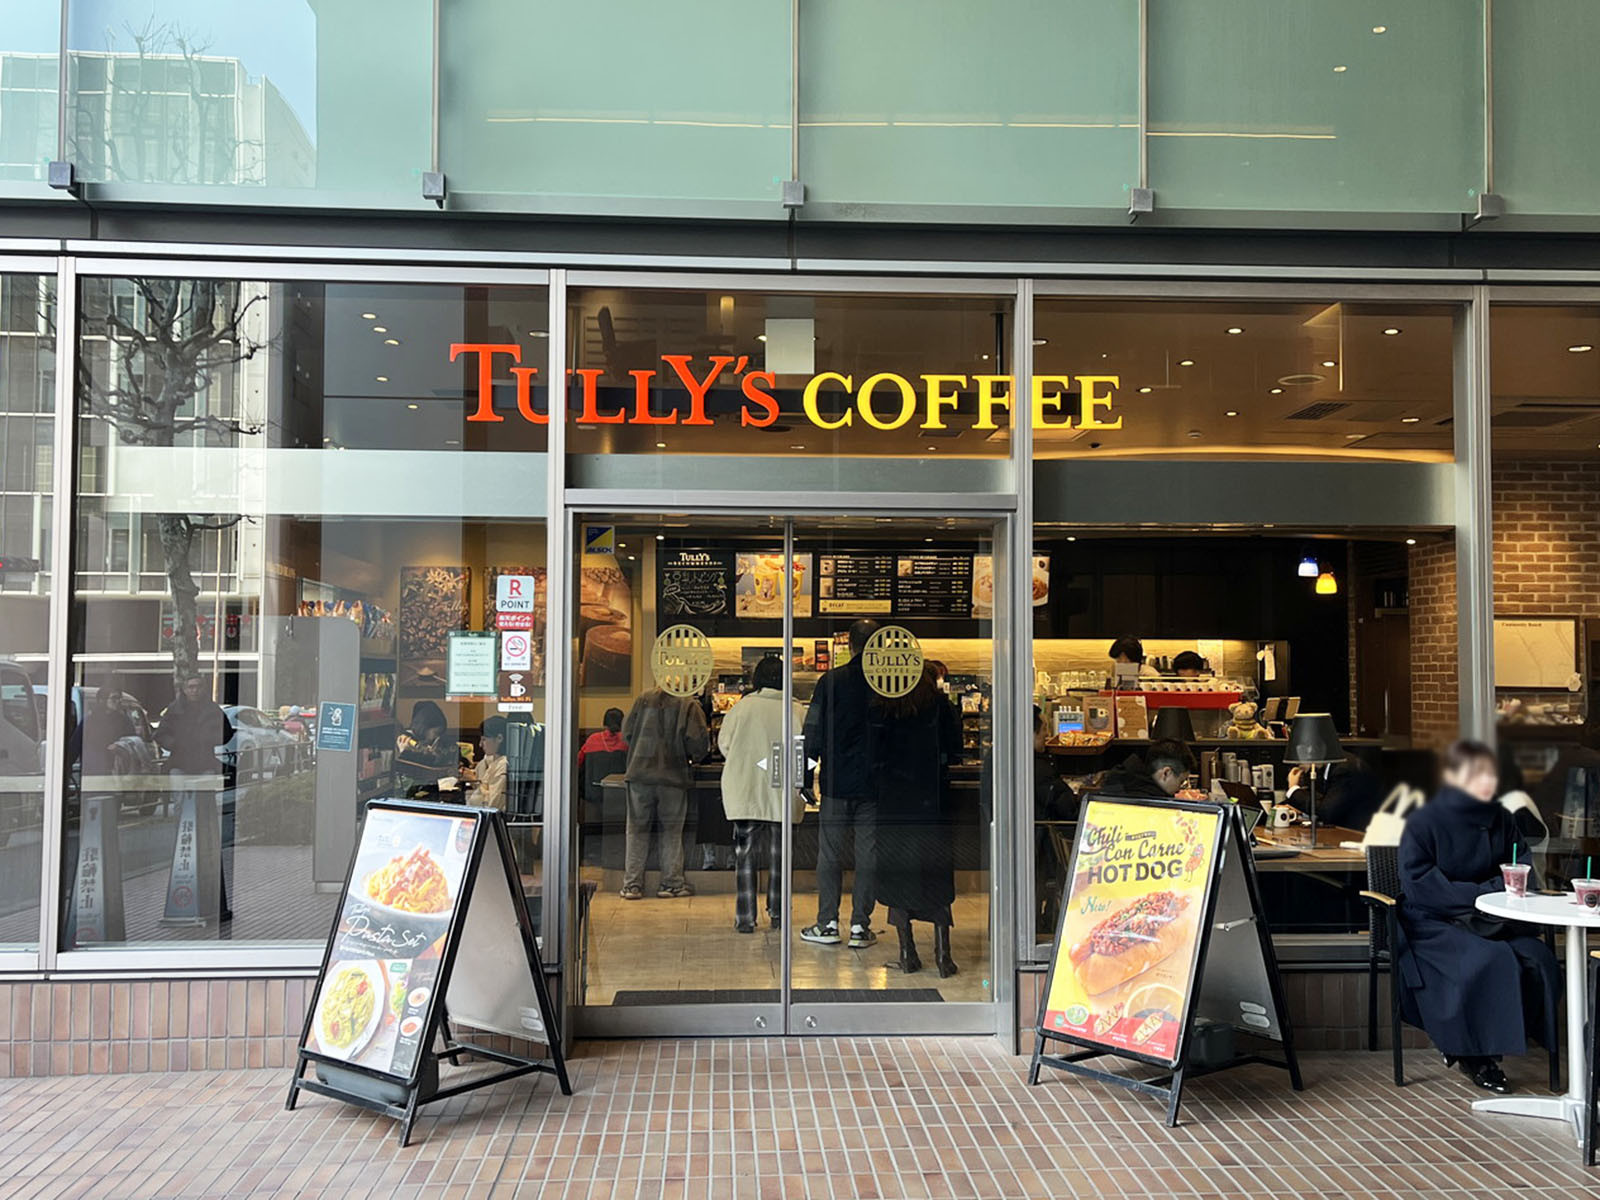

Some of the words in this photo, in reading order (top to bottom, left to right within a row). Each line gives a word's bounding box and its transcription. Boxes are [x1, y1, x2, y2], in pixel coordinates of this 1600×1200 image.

[450, 343, 780, 428] TULLY'S
[802, 372, 1123, 430] COFFEE
[509, 579, 522, 596] R
[500, 600, 530, 609] POINT
[865, 652, 921, 667] TULLY'S
[1087, 825, 1123, 847] Chili
[1103, 843, 1135, 862] Con
[1138, 839, 1185, 860] Carne
[1087, 863, 1132, 884] HOT
[1135, 859, 1183, 881] DOG
[343, 915, 395, 943] Pasta
[393, 930, 427, 948] Set
